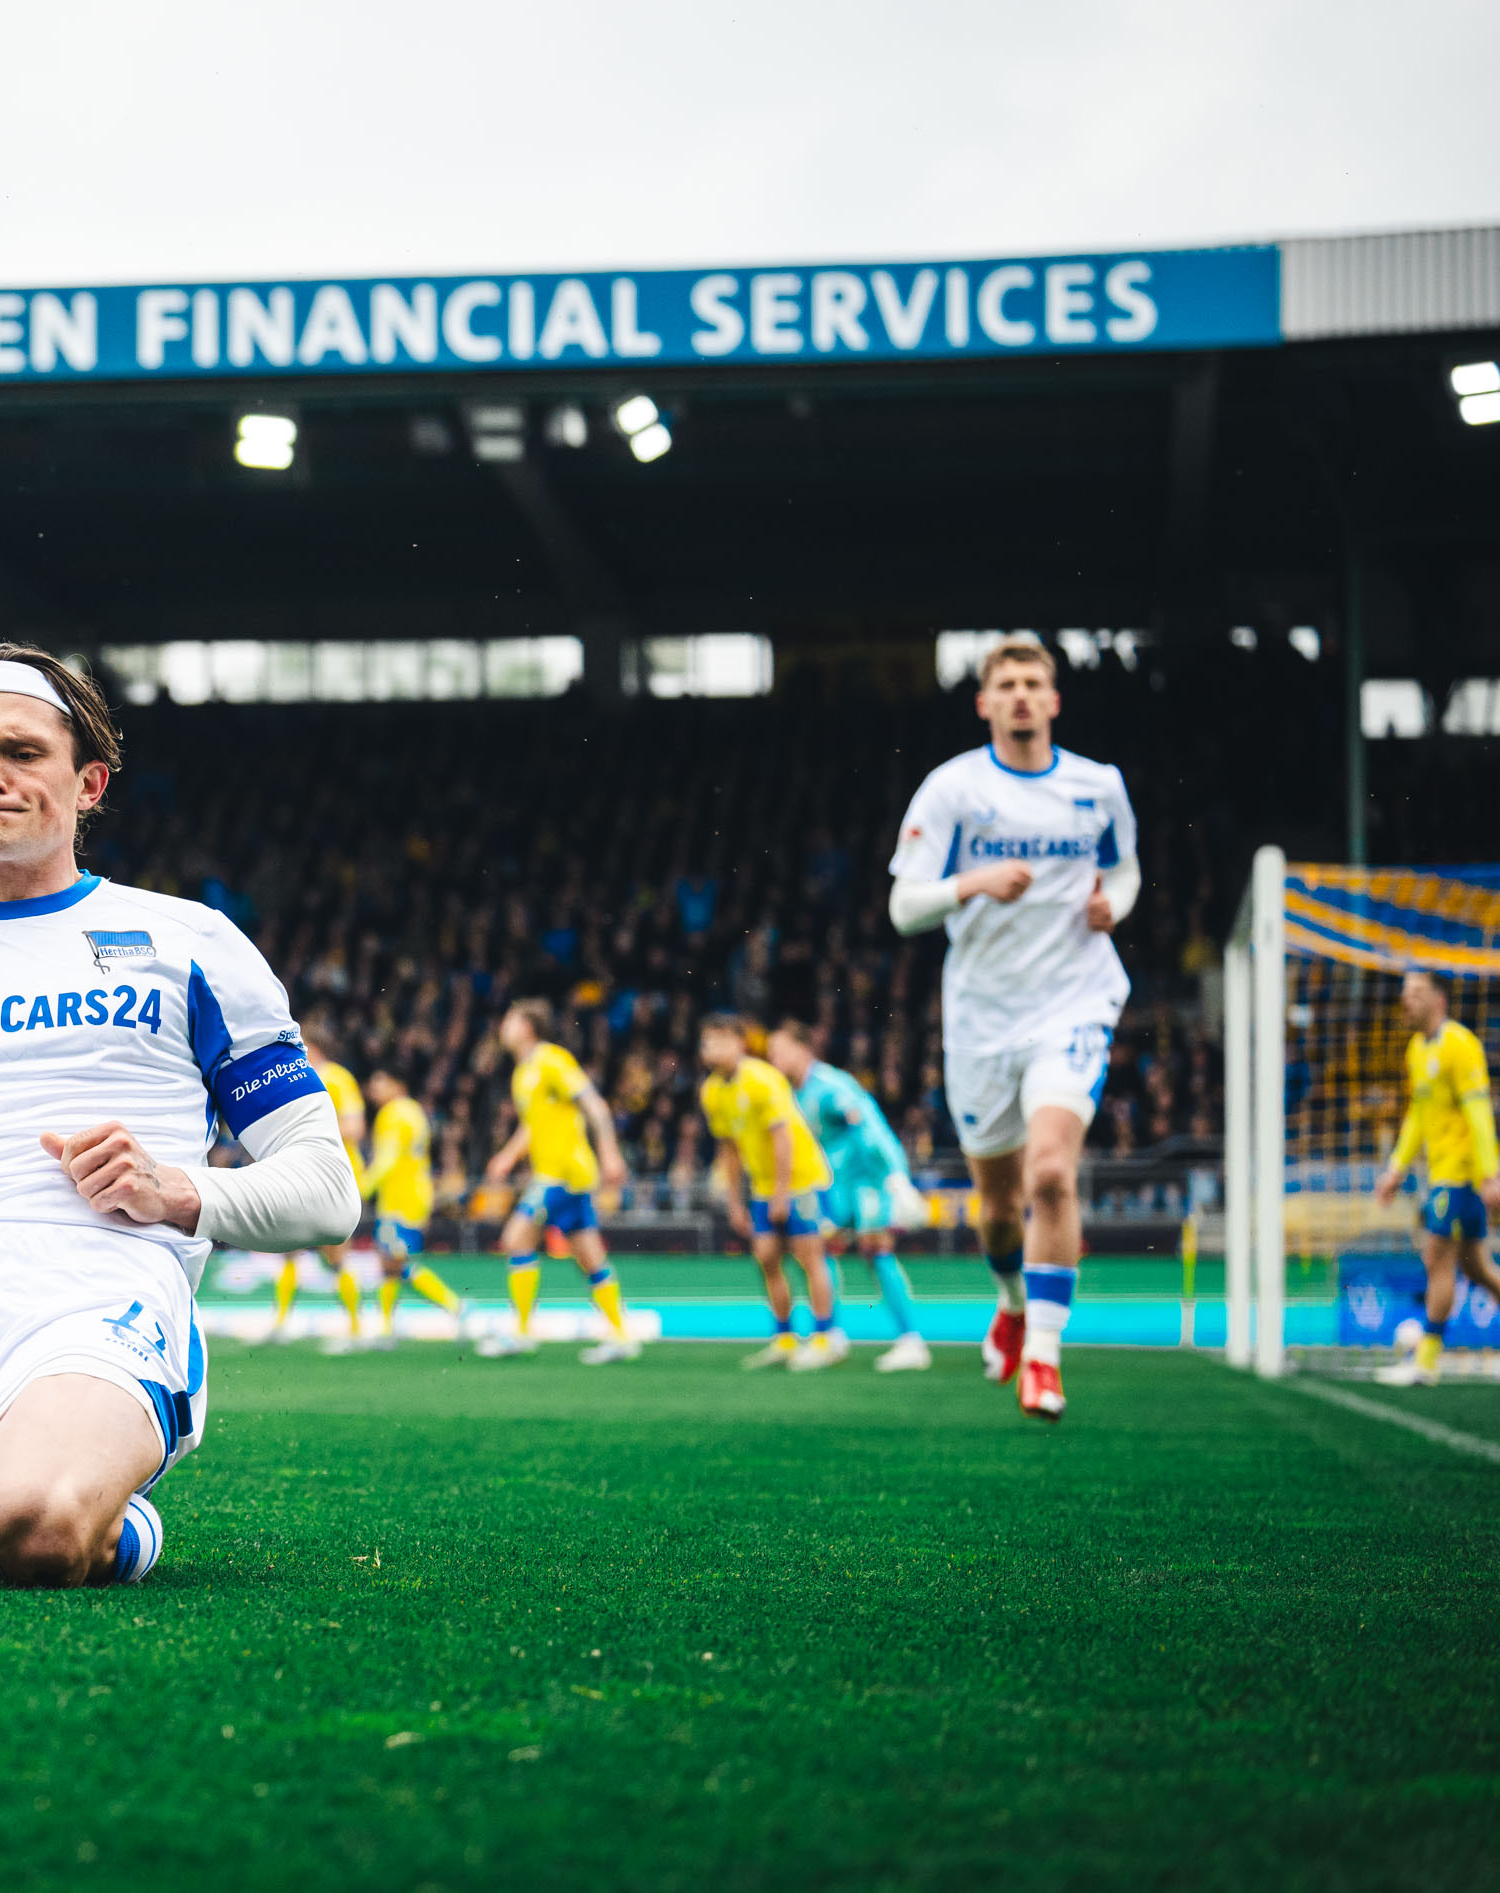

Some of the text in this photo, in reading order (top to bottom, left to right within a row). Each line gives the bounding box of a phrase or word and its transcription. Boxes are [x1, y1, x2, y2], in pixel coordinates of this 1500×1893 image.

[135, 273, 662, 370] FINANCIAL
[690, 259, 1161, 357] SERVICES
[231, 1078, 262, 1102] Die
[262, 1062, 298, 1085] Alte
[287, 1071, 308, 1083] 1892
